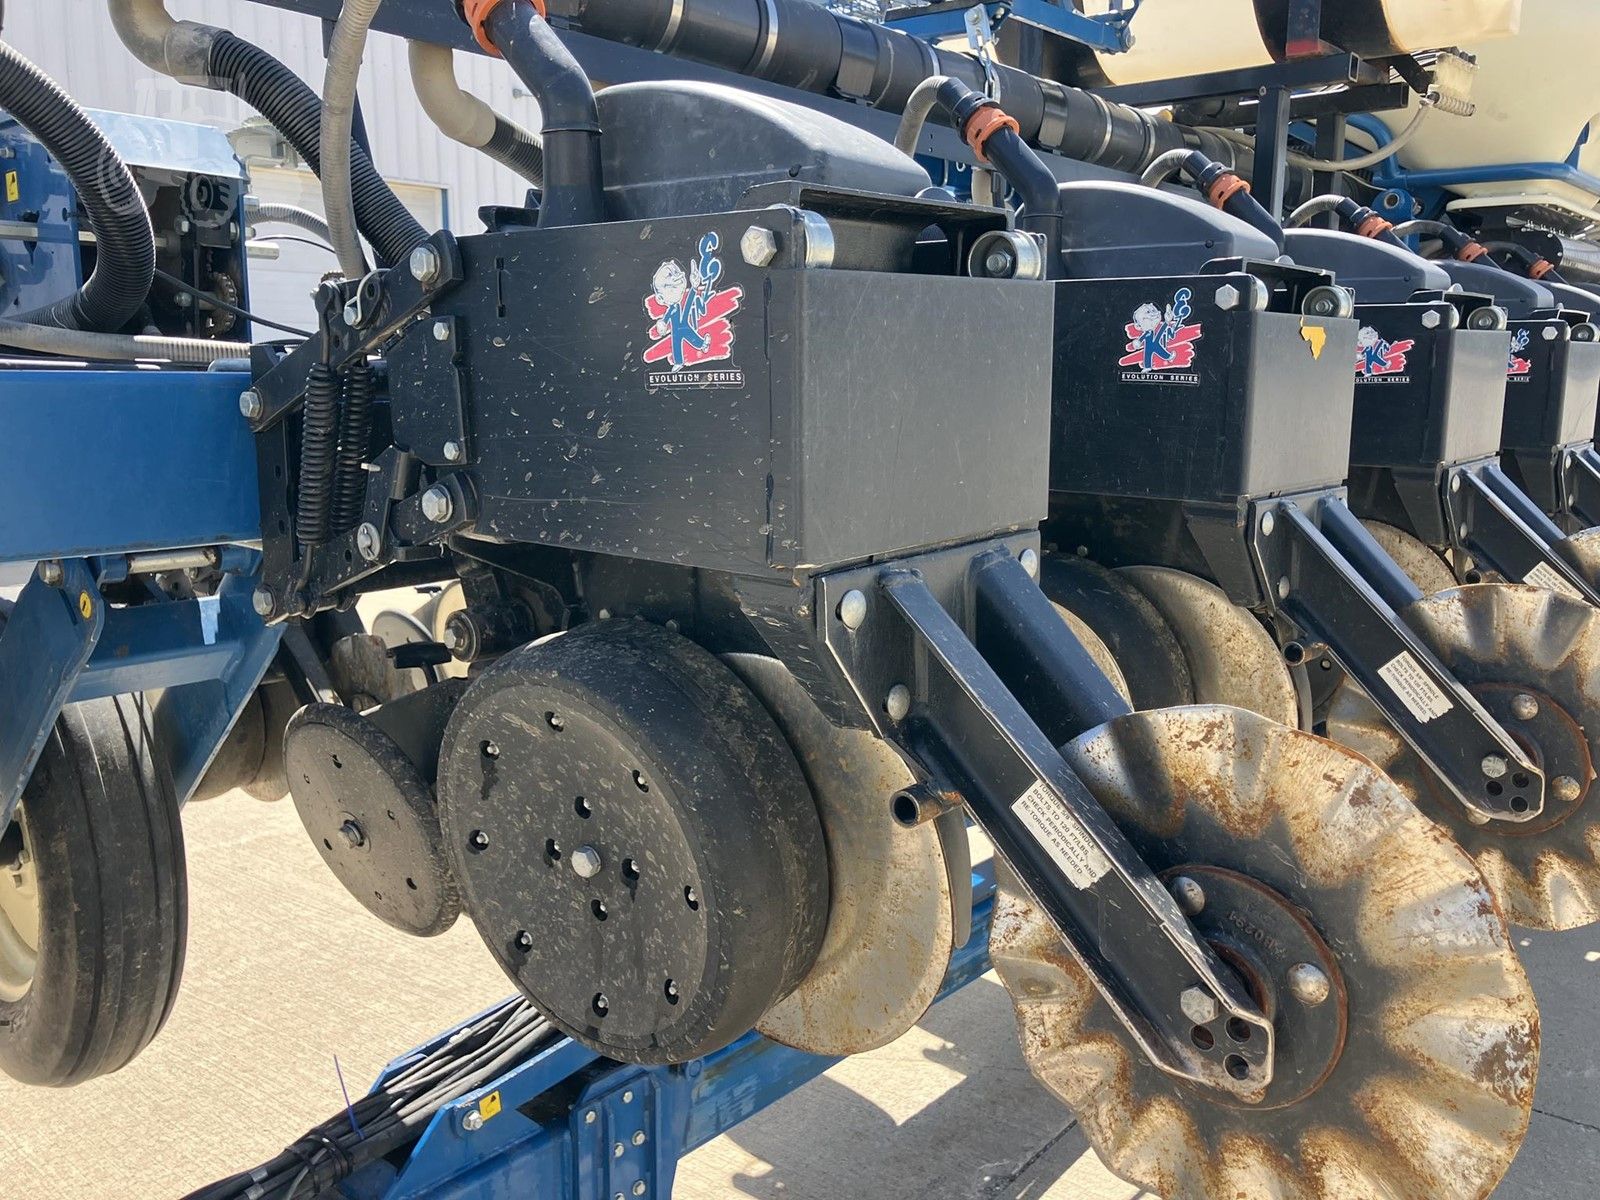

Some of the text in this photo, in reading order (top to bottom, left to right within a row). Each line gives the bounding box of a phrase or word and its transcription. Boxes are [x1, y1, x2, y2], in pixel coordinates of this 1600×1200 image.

[650, 372, 742, 383] EVOLUTION SERIES
[1031, 788, 1053, 812] BOLTS
[1050, 810, 1060, 821] TO
[1058, 821, 1070, 833] 120
[1026, 794, 1097, 879] CHECK PERIODICALLY AND
[1051, 837, 1061, 848] AS
